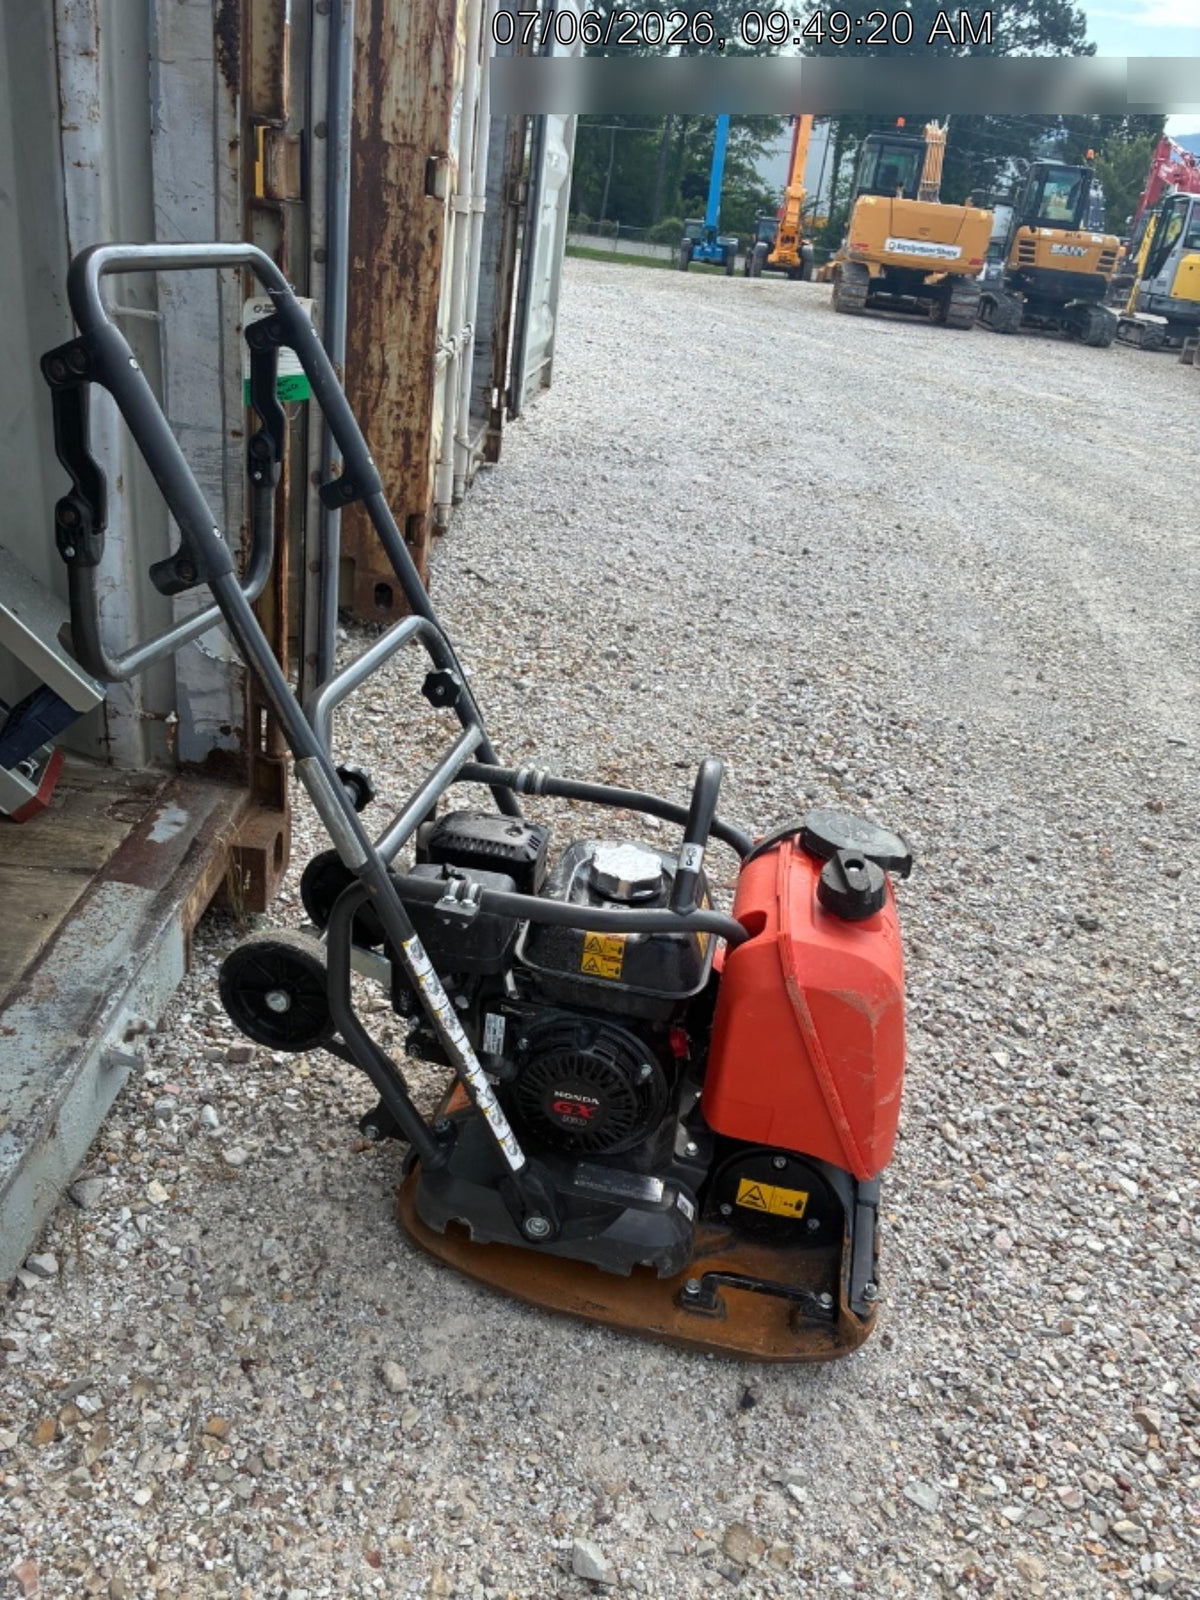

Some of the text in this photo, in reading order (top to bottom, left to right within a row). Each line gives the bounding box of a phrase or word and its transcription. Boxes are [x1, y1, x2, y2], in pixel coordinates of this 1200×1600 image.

[1051, 243, 1088, 257] SANY
[553, 1090, 600, 1105] HONDA
[552, 1100, 598, 1119] GX
